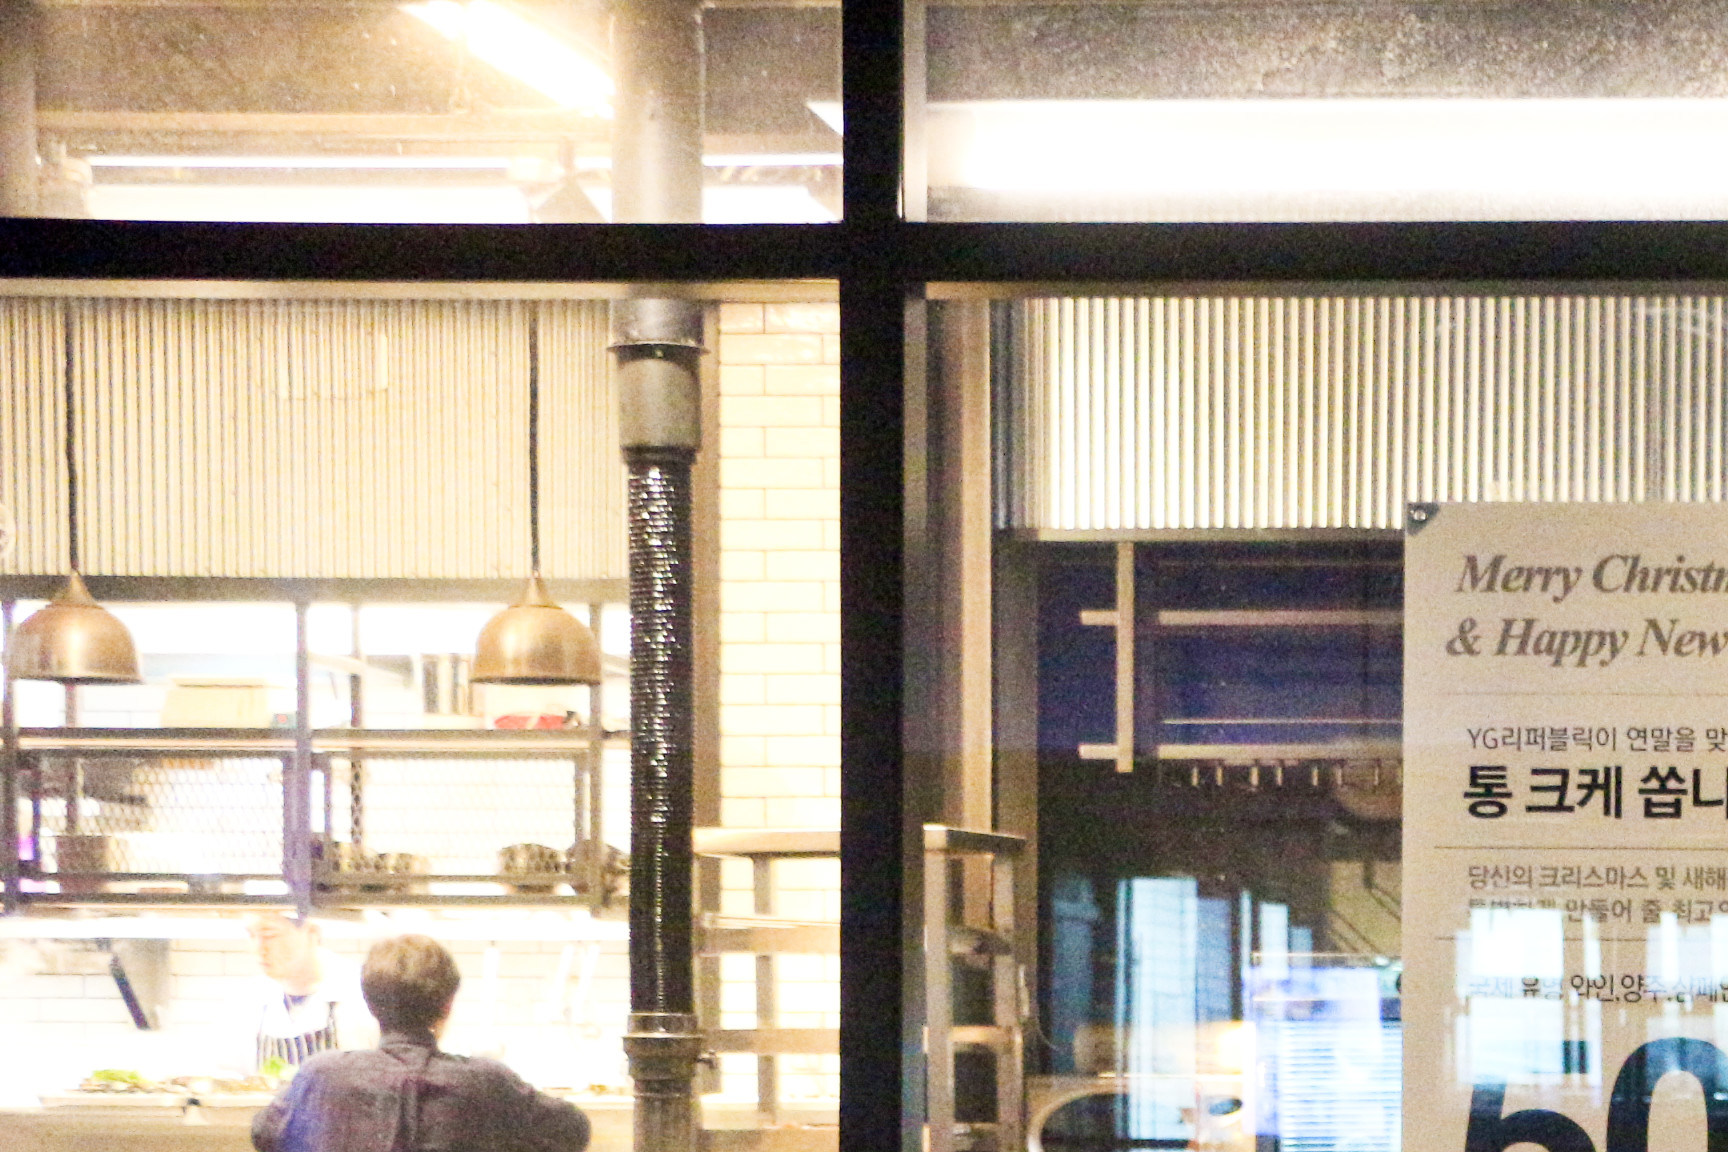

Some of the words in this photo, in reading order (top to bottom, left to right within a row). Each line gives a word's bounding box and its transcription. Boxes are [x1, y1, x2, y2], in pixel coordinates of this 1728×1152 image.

[1454, 554, 1583, 603] Merry
[1445, 617, 1482, 657] &
[1494, 618, 1628, 667] Happy
[1466, 727, 1617, 752] YG리퍼블릭이
[1627, 727, 1696, 752] 연말을
[1463, 765, 1513, 819] 통
[1525, 766, 1623, 819] 크케
[1469, 865, 1533, 890] 당신의
[1540, 865, 1649, 890] 크리스마스
[1655, 865, 1677, 891] 및
[1566, 898, 1632, 923] 만들어
